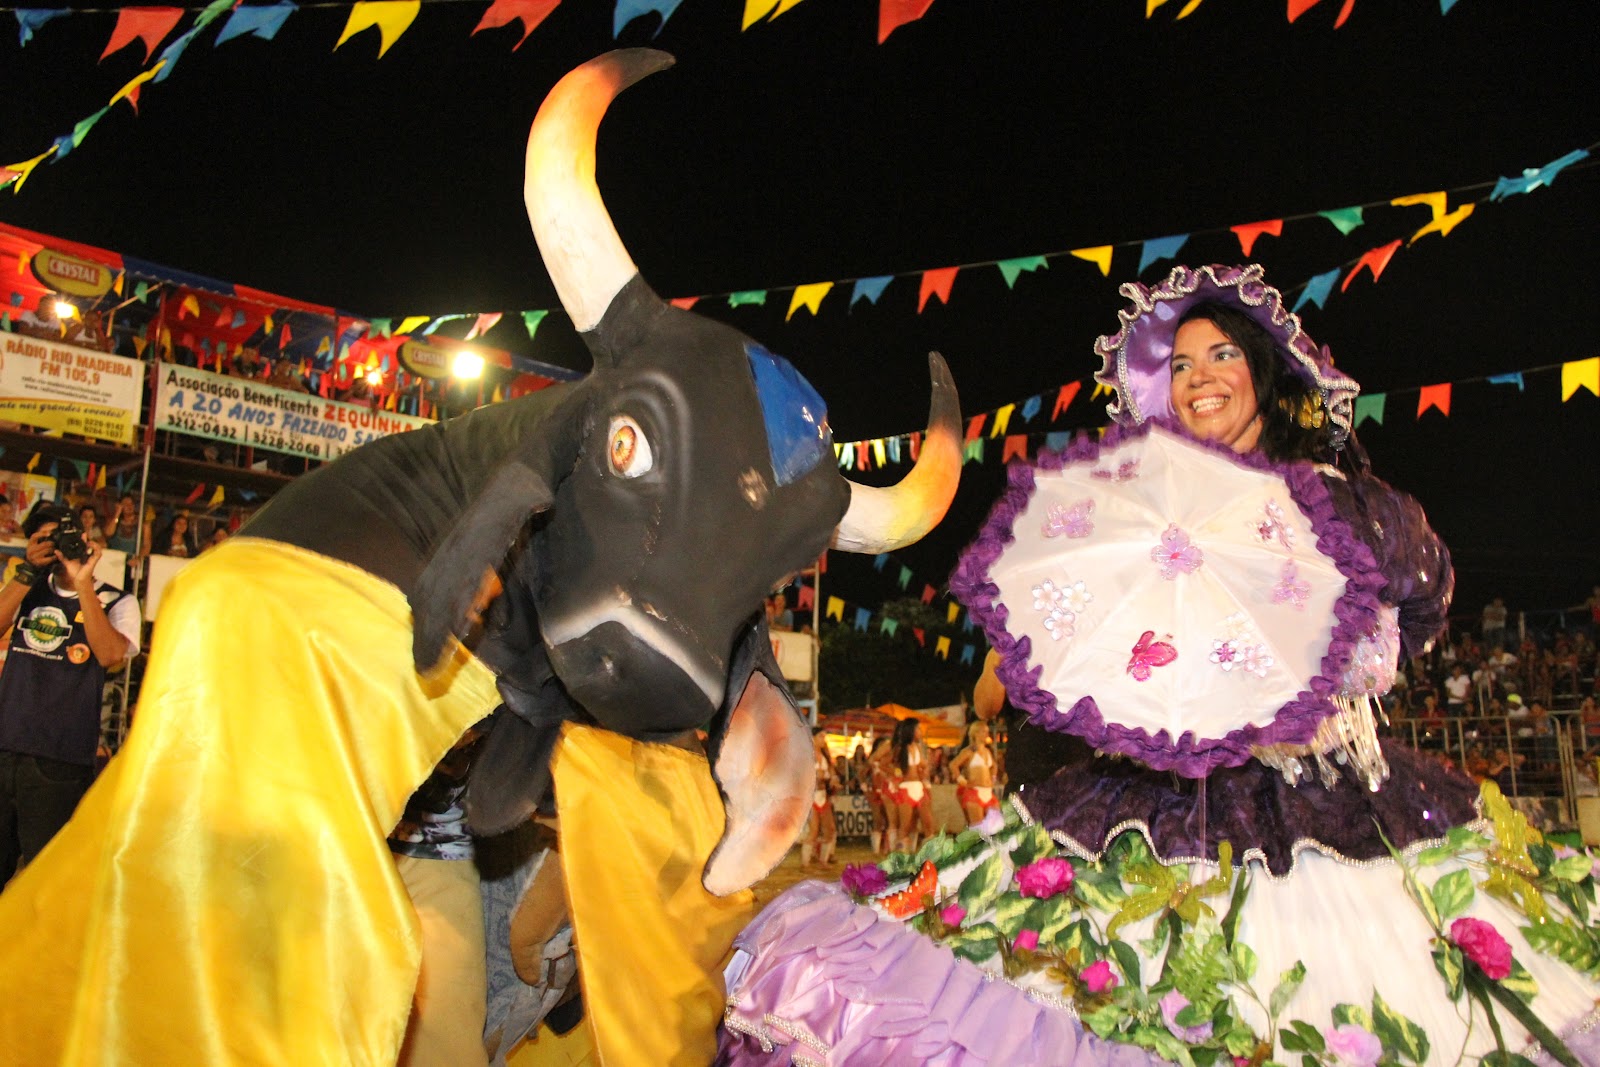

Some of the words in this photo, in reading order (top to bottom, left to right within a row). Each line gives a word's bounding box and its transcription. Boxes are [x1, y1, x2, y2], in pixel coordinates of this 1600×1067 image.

[49, 258, 96, 284] CRYSTAL
[6, 338, 48, 360] RÁDIO
[51, 350, 73, 366] RIO
[76, 354, 133, 378] MADEIRA
[40, 361, 61, 377] FM
[64, 366, 100, 386] 105,9
[166, 369, 240, 400] Associação
[243, 386, 319, 416] Beneficente
[167, 413, 238, 439] 3212-0432
[253, 431, 320, 457] 3228-2068
[169, 390, 185, 408] A
[192, 392, 222, 415] 20
[227, 402, 276, 427] ANOS
[280, 412, 347, 442] FAZENDO
